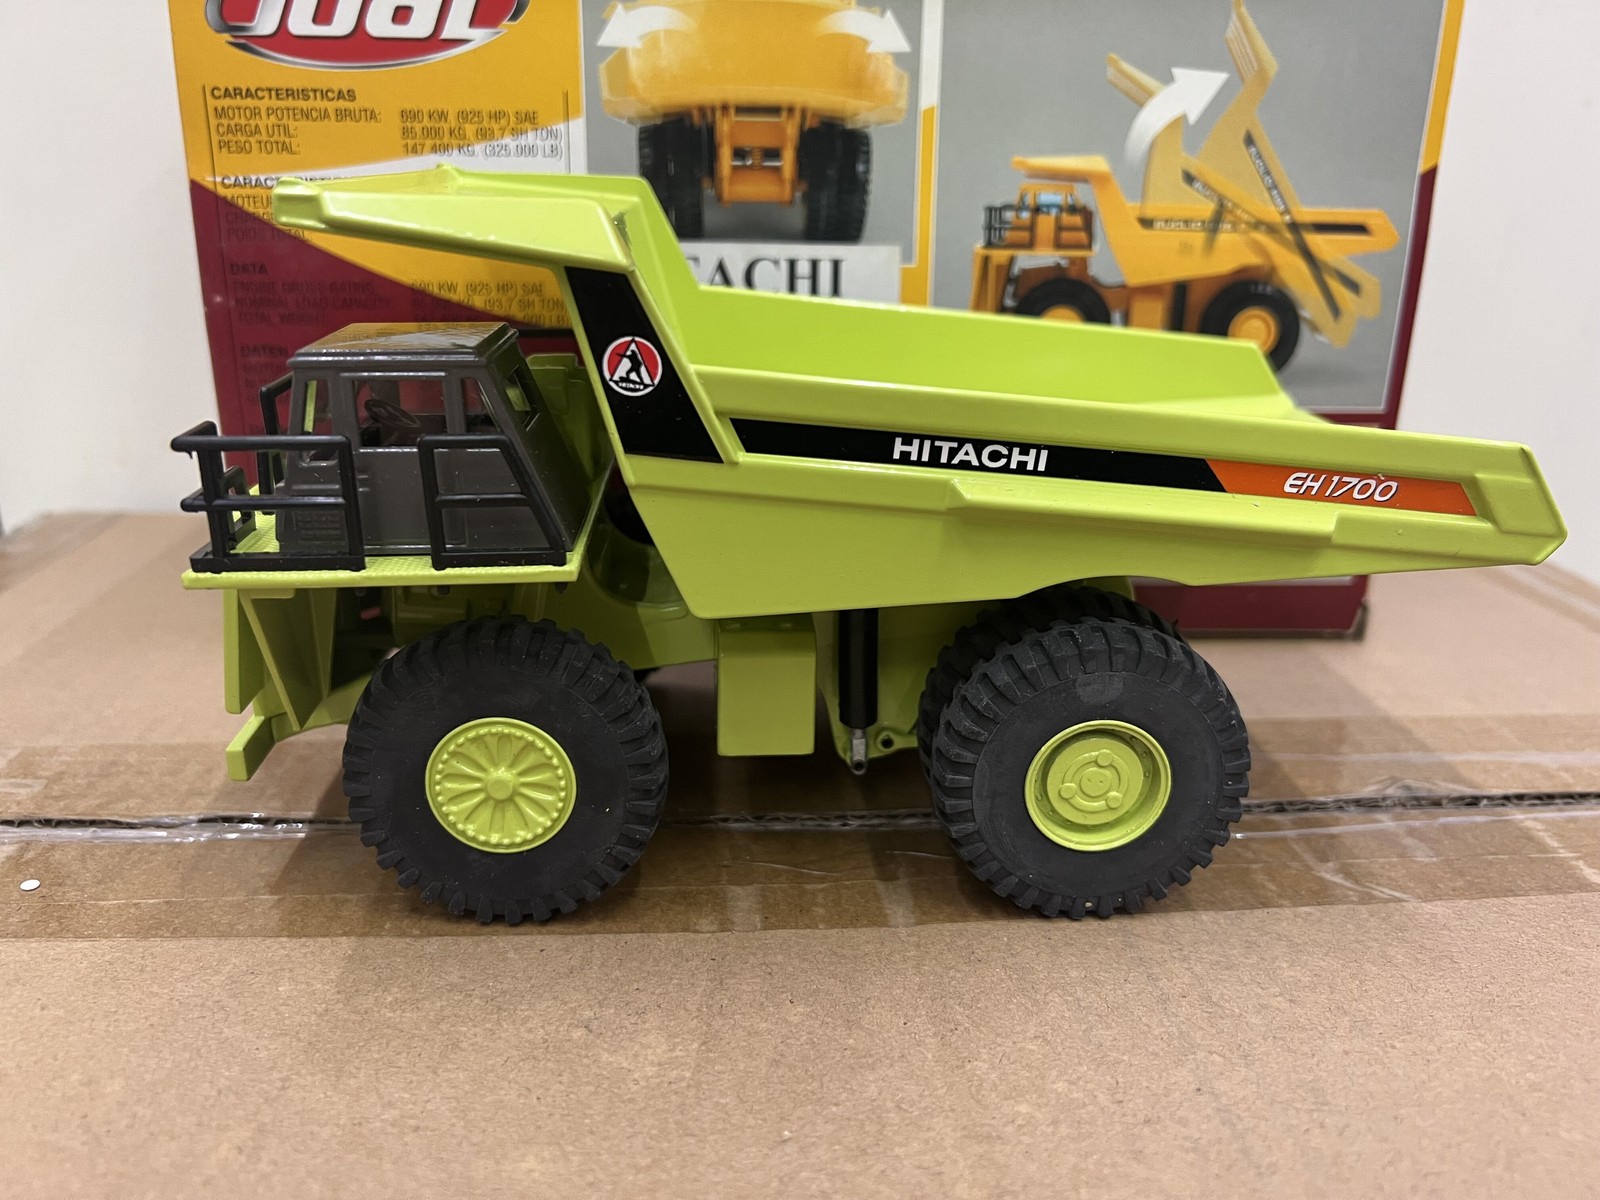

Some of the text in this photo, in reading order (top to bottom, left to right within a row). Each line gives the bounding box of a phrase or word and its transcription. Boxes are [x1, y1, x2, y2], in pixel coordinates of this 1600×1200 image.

[211, 86, 357, 102] CARACTERISTICAS
[214, 105, 262, 121] MOTOR
[267, 106, 331, 122] POTENCIA
[216, 122, 262, 138] CARGA
[219, 139, 253, 155] PESO
[892, 437, 1048, 471] HITACHI
